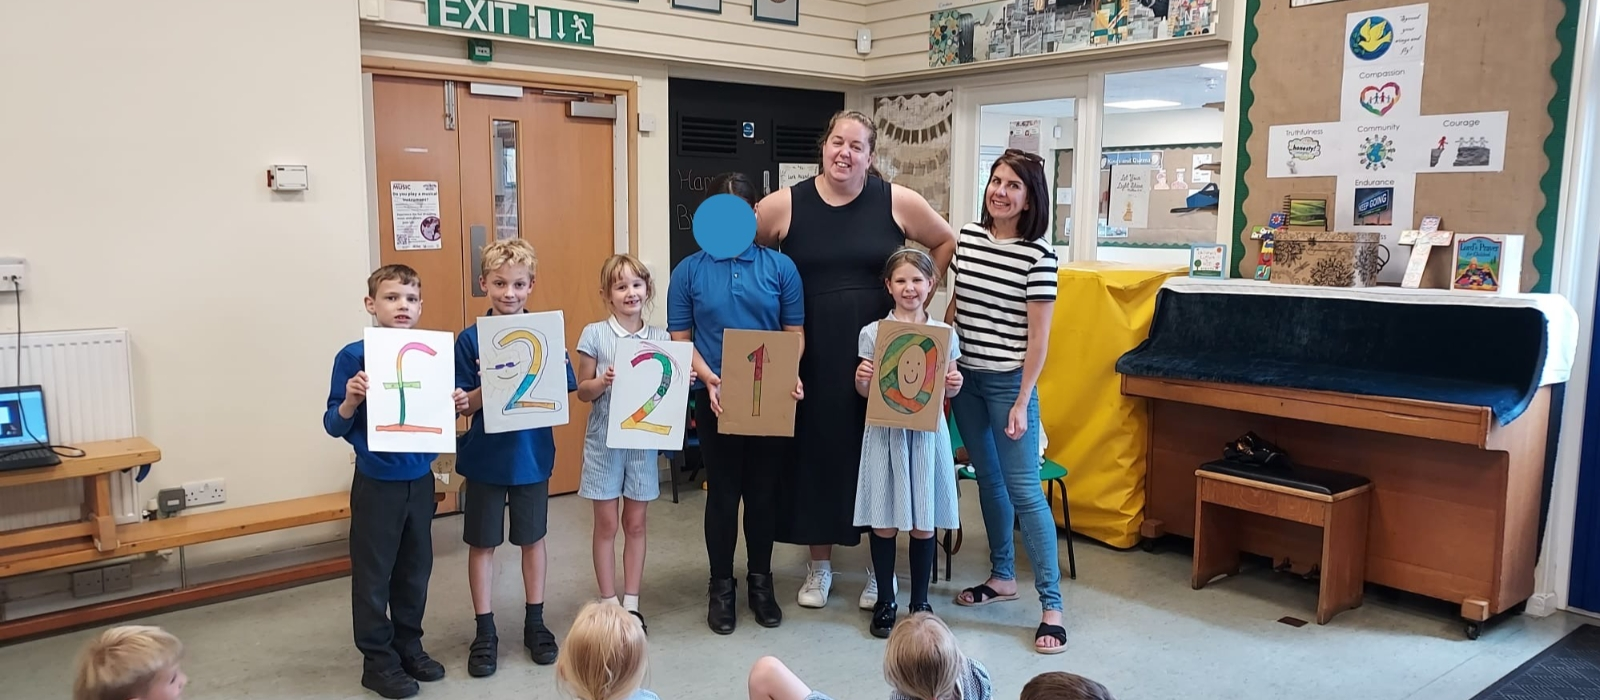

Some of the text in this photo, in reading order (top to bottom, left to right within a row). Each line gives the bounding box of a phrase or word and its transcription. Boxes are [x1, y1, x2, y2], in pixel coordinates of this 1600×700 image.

[439, 0, 518, 34] EXIT
[1400, 27, 1415, 35] your
[1400, 45, 1413, 56] fly!
[1359, 69, 1405, 80] Compassion
[1357, 124, 1400, 133] Community
[1443, 119, 1480, 128] Courage
[1286, 129, 1324, 137] Truthfulness
[1292, 144, 1317, 153] honesty!
[677, 168, 715, 193] Hap
[1129, 173, 1141, 182] Your
[1355, 178, 1395, 186] Endurance
[1117, 182, 1130, 192] Light
[1370, 193, 1387, 208] GOING
[1460, 242, 1499, 251] Lord's Prayer
[497, 329, 556, 411] 2
[878, 333, 938, 414] 0
[747, 342, 768, 417] 1
[375, 341, 443, 434] £
[620, 351, 673, 436] 2
